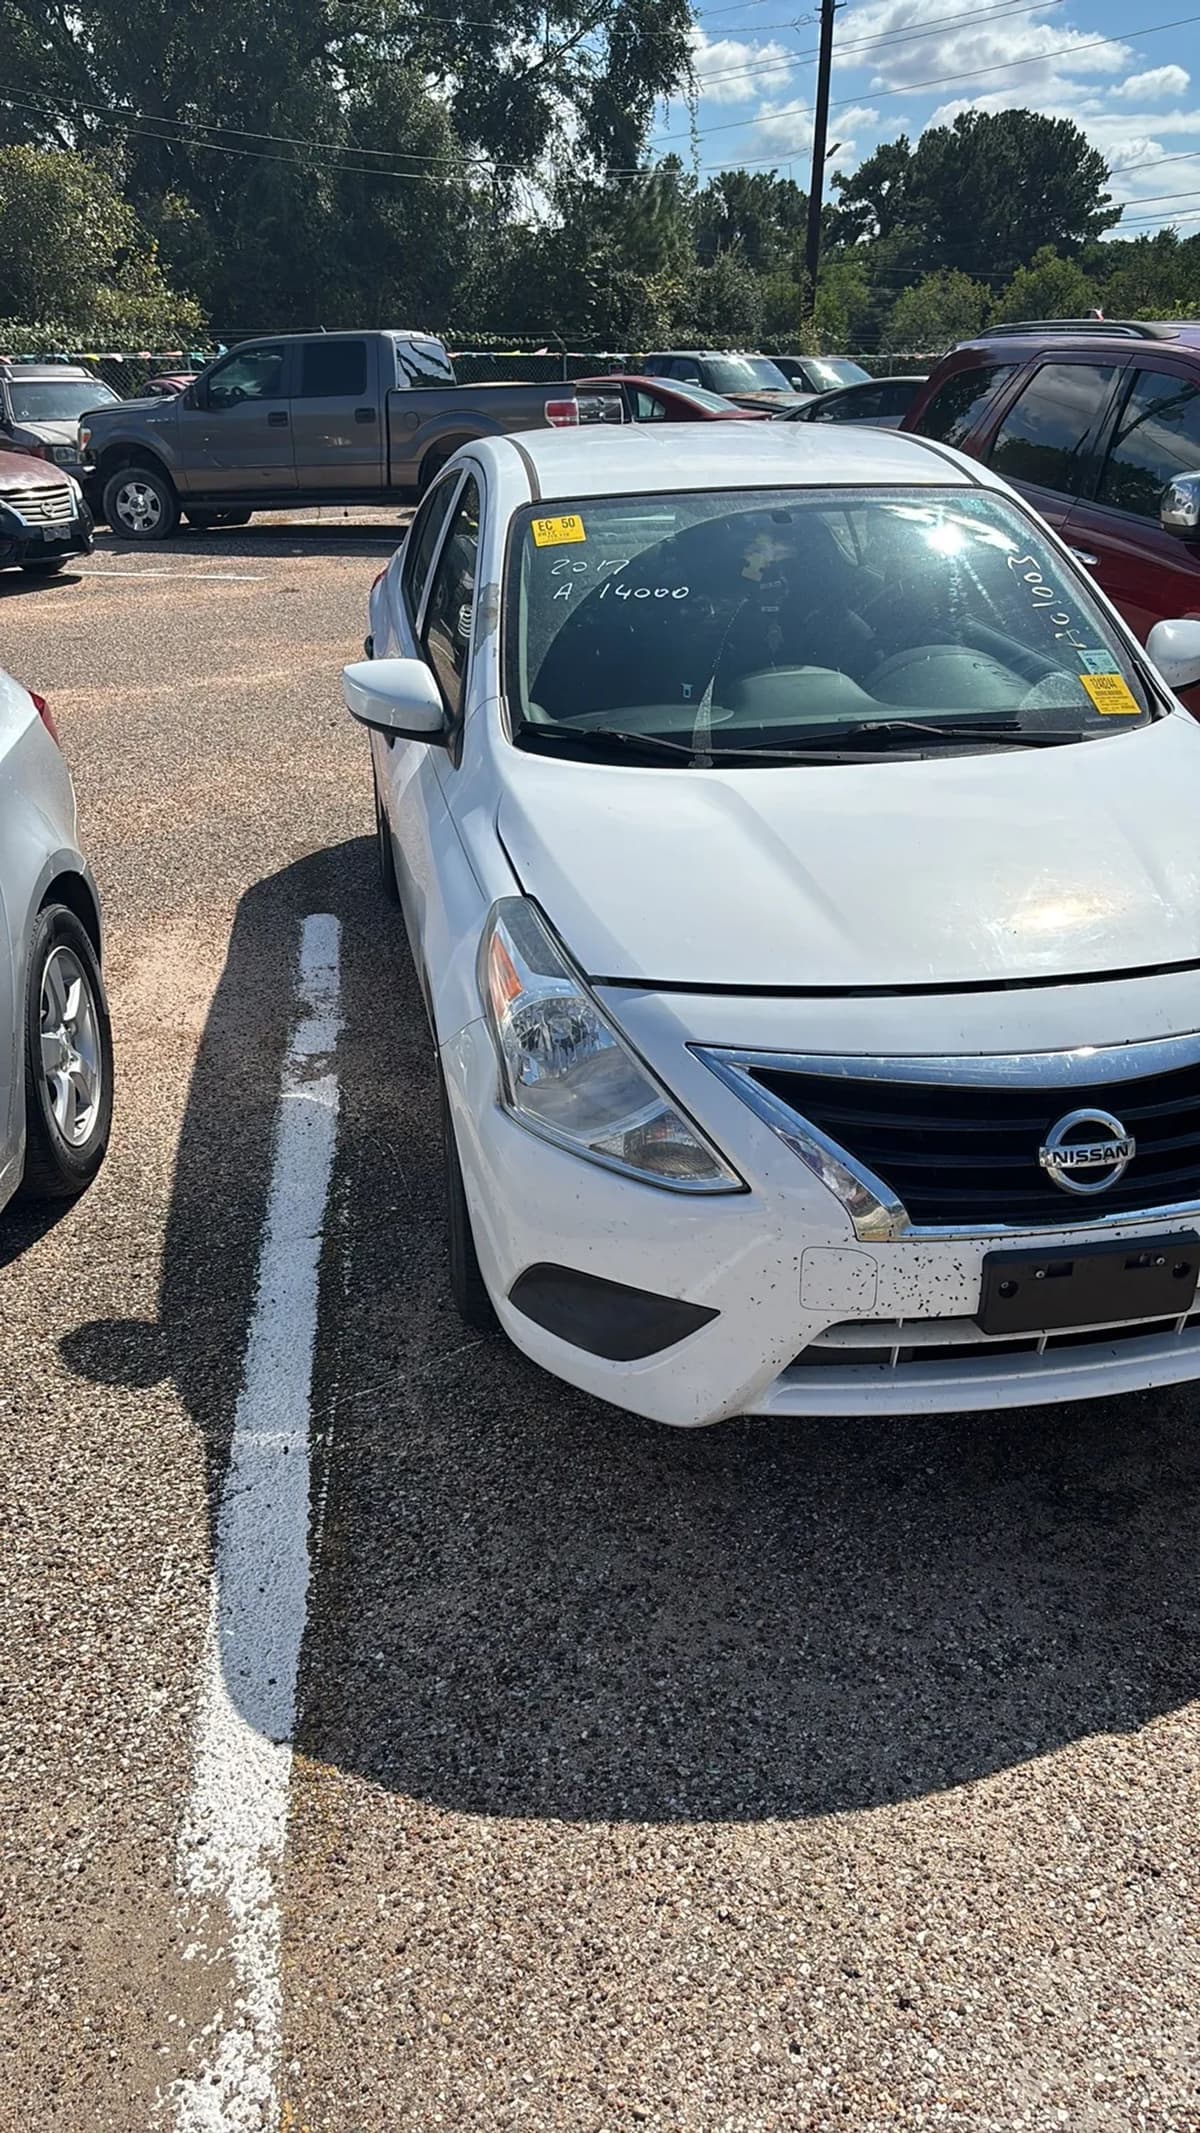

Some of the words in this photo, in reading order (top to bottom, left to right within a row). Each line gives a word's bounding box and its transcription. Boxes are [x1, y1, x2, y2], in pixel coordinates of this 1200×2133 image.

[538, 520, 553, 531] EC
[561, 518, 575, 528] 50
[551, 558, 630, 576] 2017
[552, 582, 574, 601] A
[599, 582, 690, 601] 14000
[1052, 1145, 1129, 1164] NISSAN
